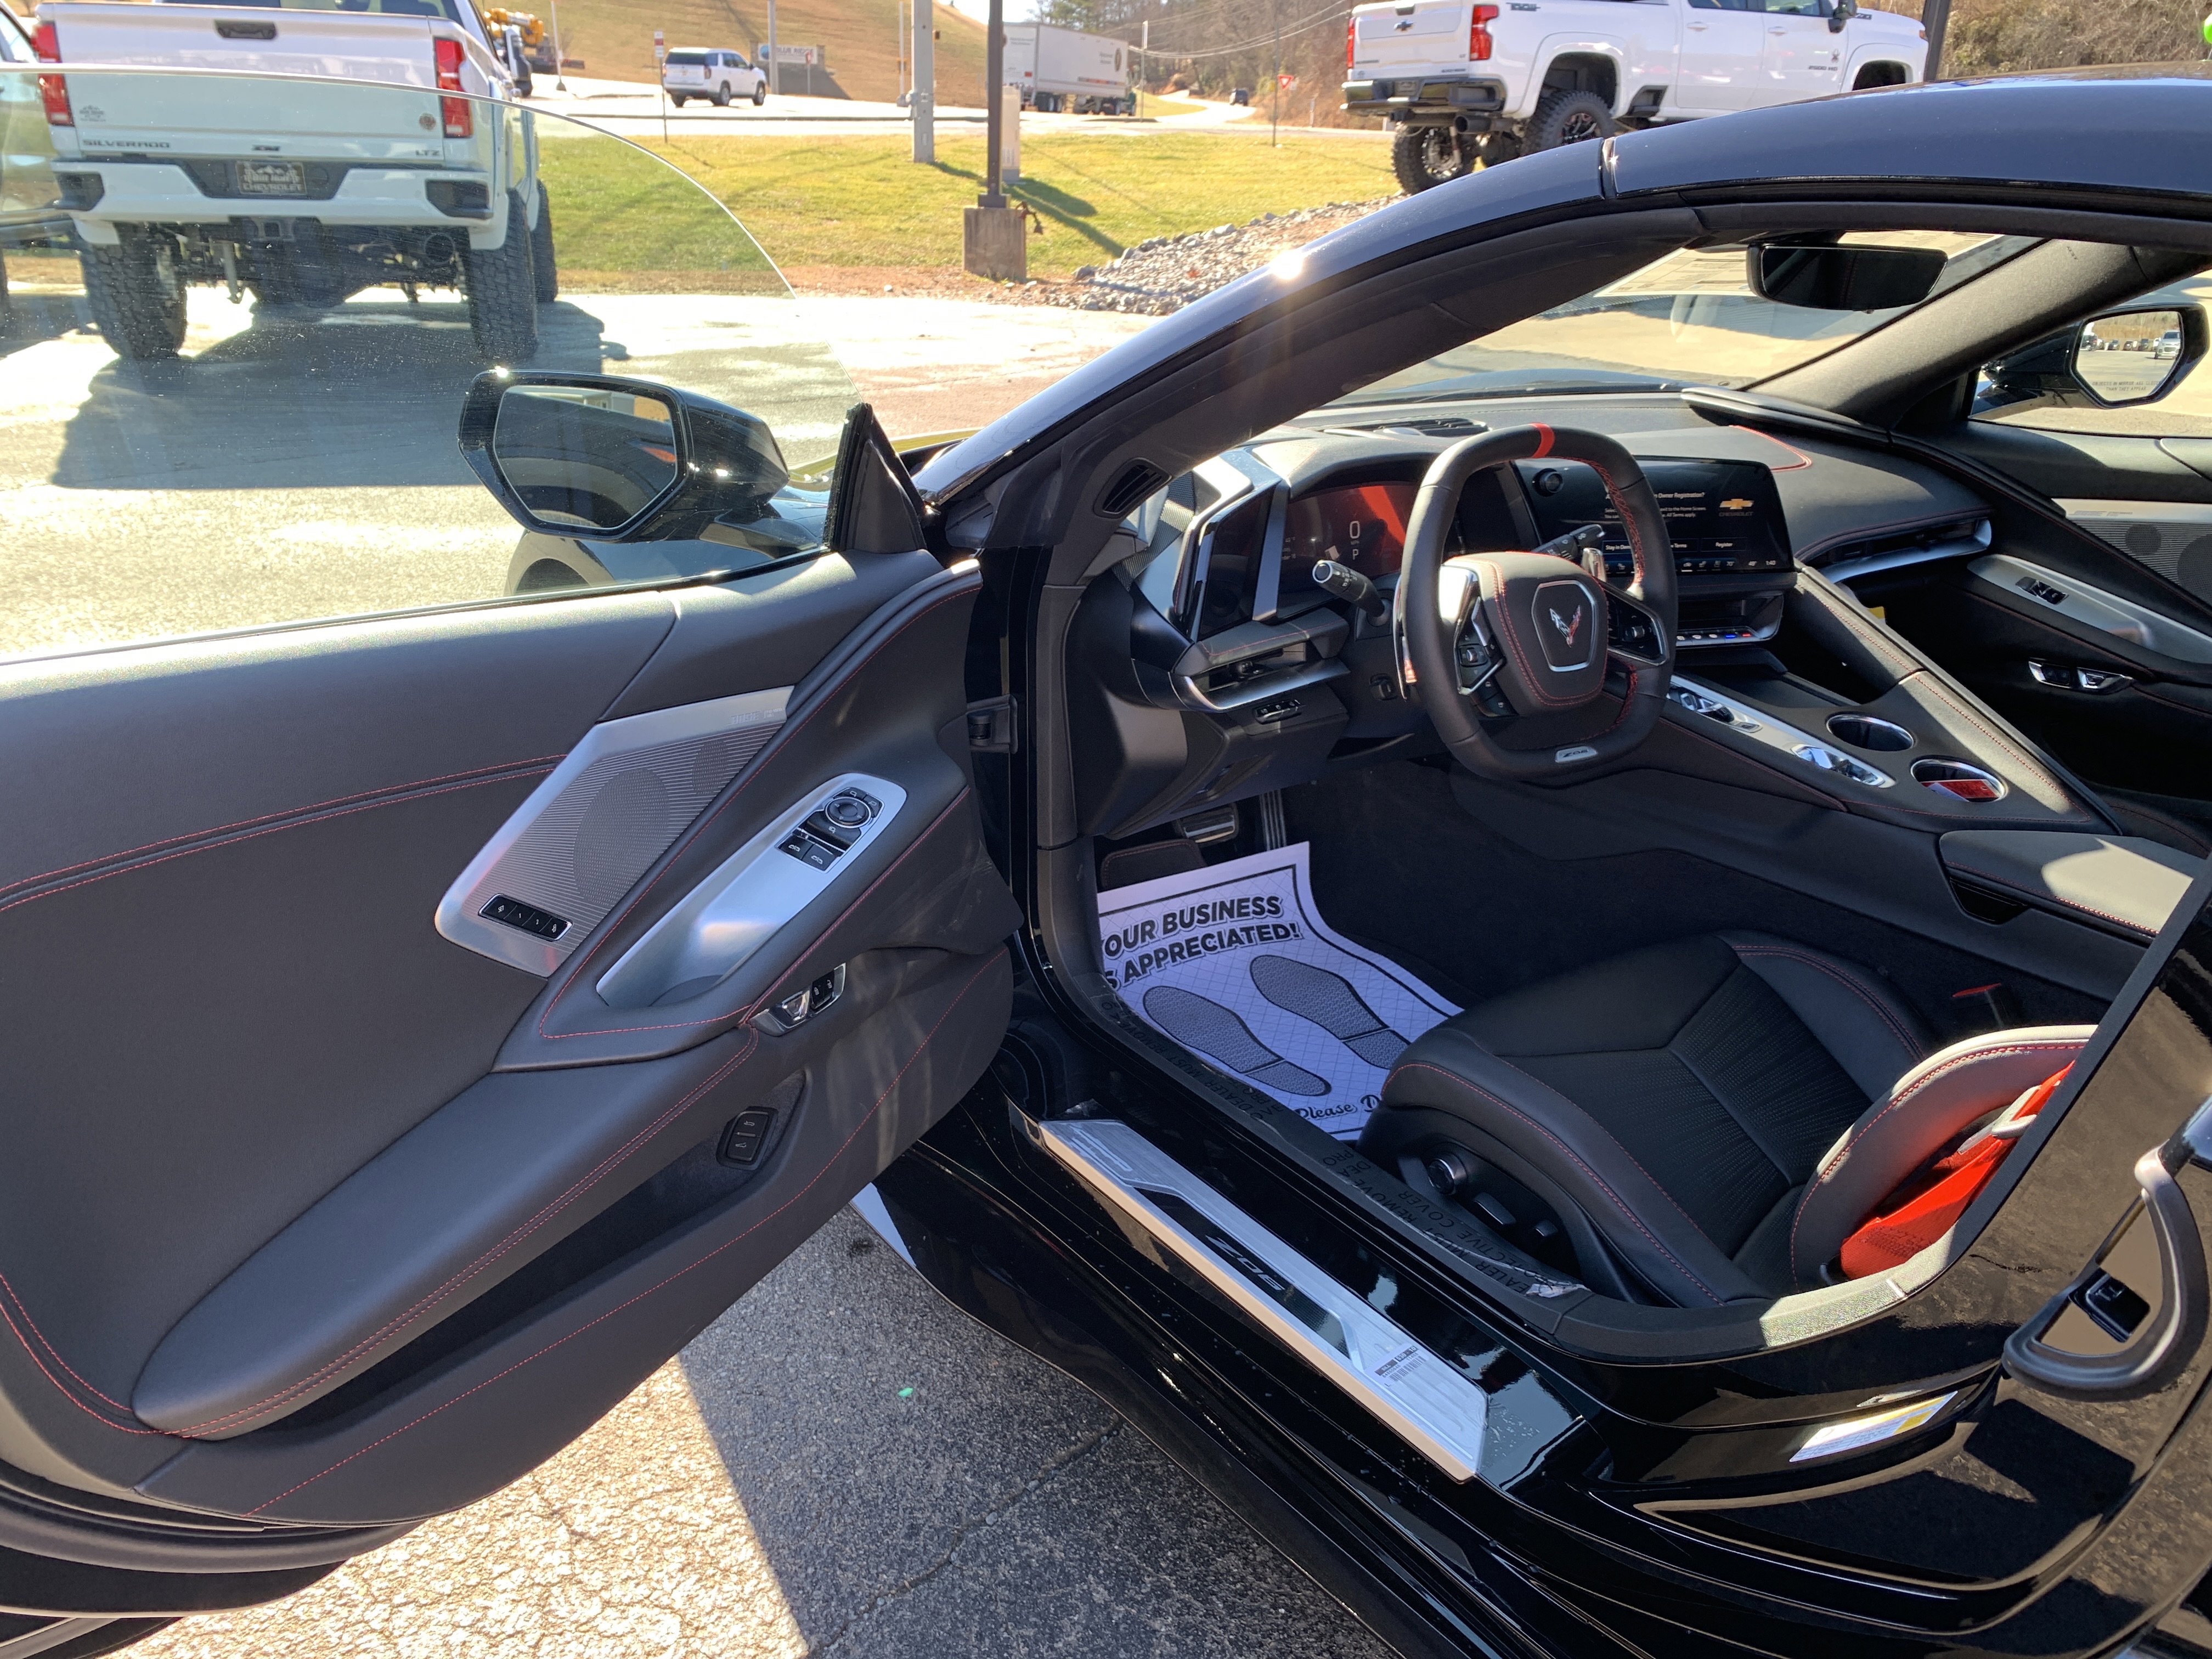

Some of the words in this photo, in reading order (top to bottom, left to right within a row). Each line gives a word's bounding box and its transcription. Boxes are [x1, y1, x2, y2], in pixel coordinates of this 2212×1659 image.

[83, 139, 171, 149] SILVERADO
[1352, 549, 1359, 560] P
[1103, 919, 1157, 957] OUR
[1163, 895, 1282, 935] BUSINESS
[1124, 922, 1300, 984] APPRECIATED!
[1295, 1104, 1354, 1119] Please
[1354, 1179, 1417, 1223] REMOVE
[1398, 1190, 1454, 1227] COVER
[1205, 1234, 1285, 1290] Z06
[1475, 1261, 1531, 1293] EALER
